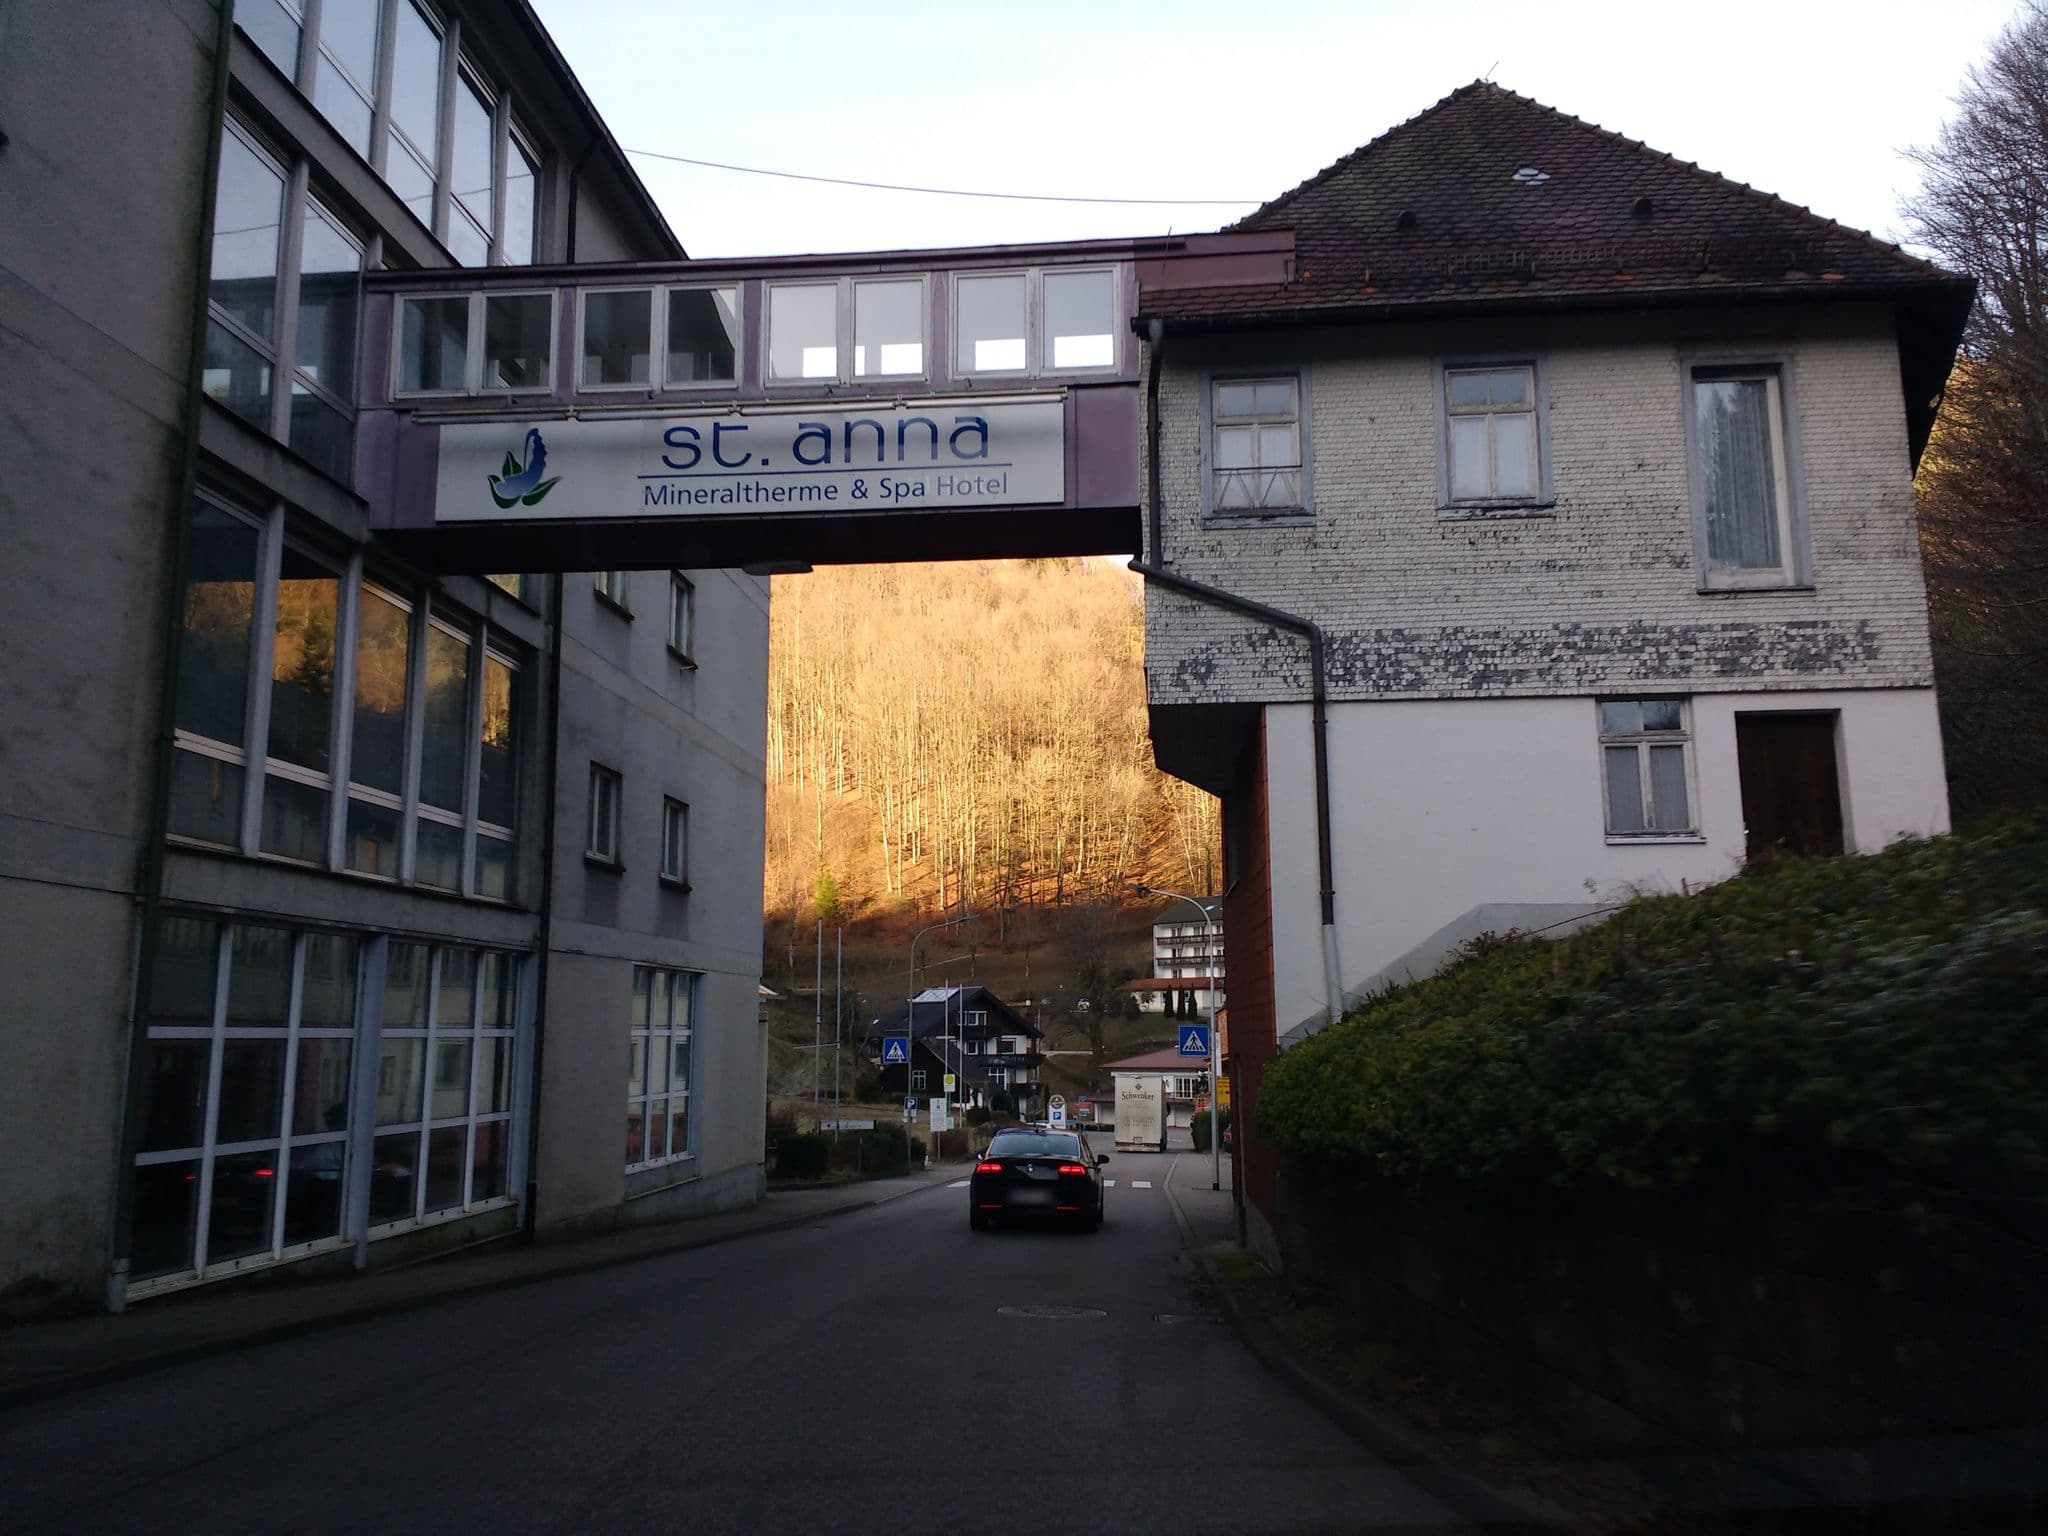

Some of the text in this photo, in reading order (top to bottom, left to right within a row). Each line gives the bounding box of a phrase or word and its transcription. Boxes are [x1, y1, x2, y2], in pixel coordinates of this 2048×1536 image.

[661, 416, 990, 470] st. anna
[643, 472, 1008, 507] Mineraltherme & Spa Hotel
